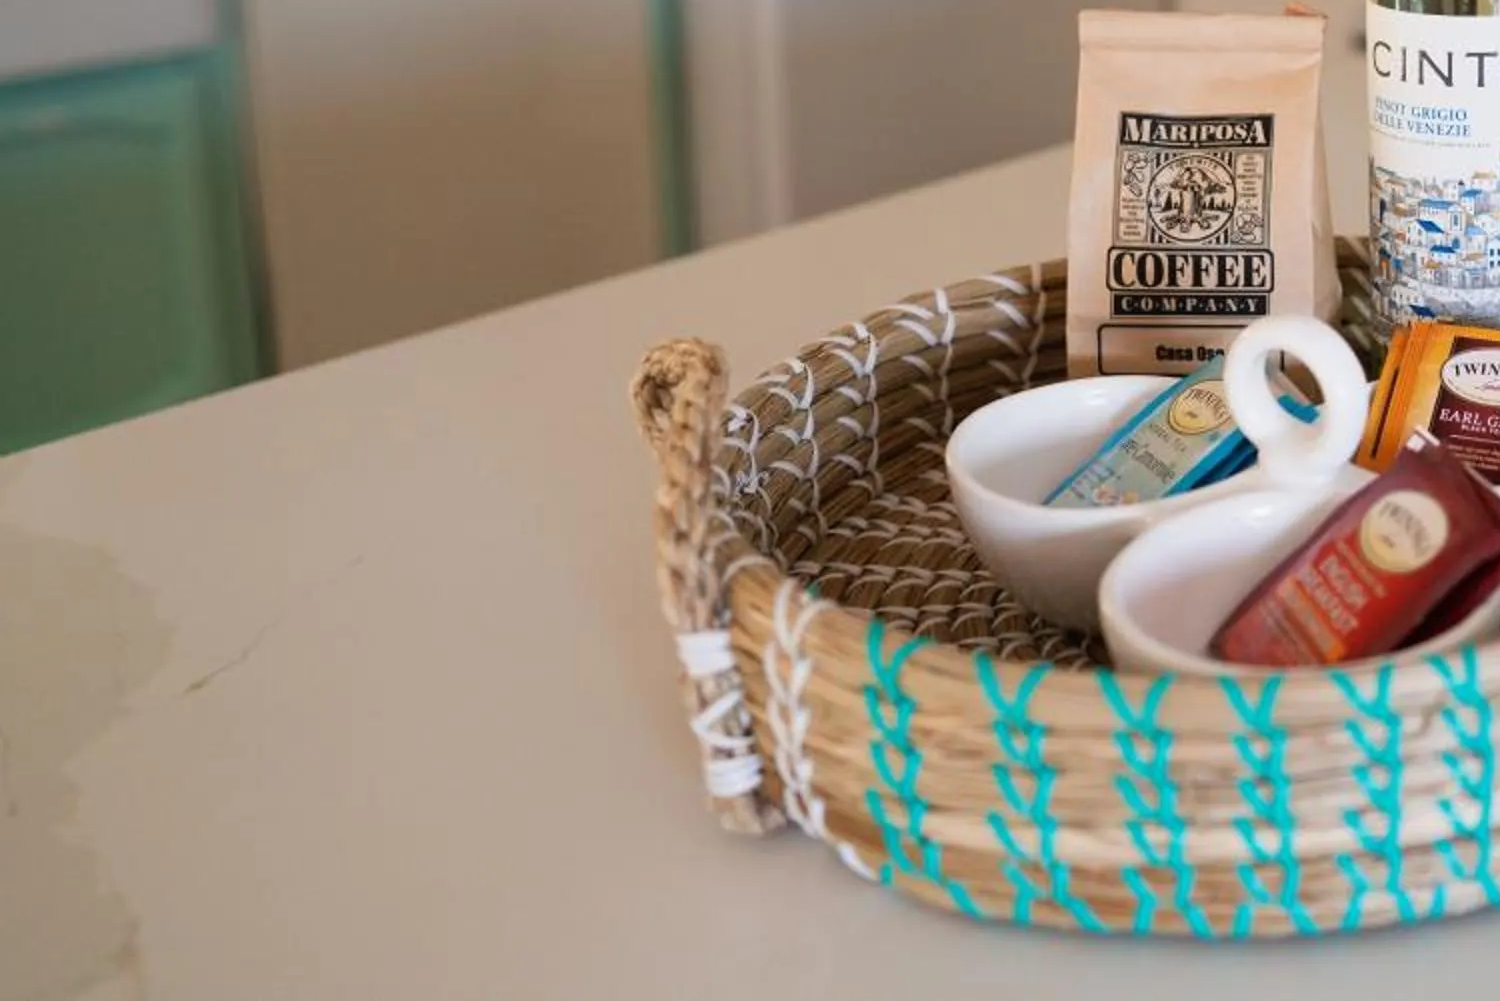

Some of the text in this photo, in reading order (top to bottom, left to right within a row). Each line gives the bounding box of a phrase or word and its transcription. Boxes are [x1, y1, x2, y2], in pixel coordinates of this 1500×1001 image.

[1411, 106, 1468, 122] GRIGIO
[1124, 117, 1267, 146] MARIPOSA
[1407, 120, 1471, 137] VENEZIE
[1113, 252, 1267, 288] COFFEE
[1439, 408, 1483, 425] EARL
